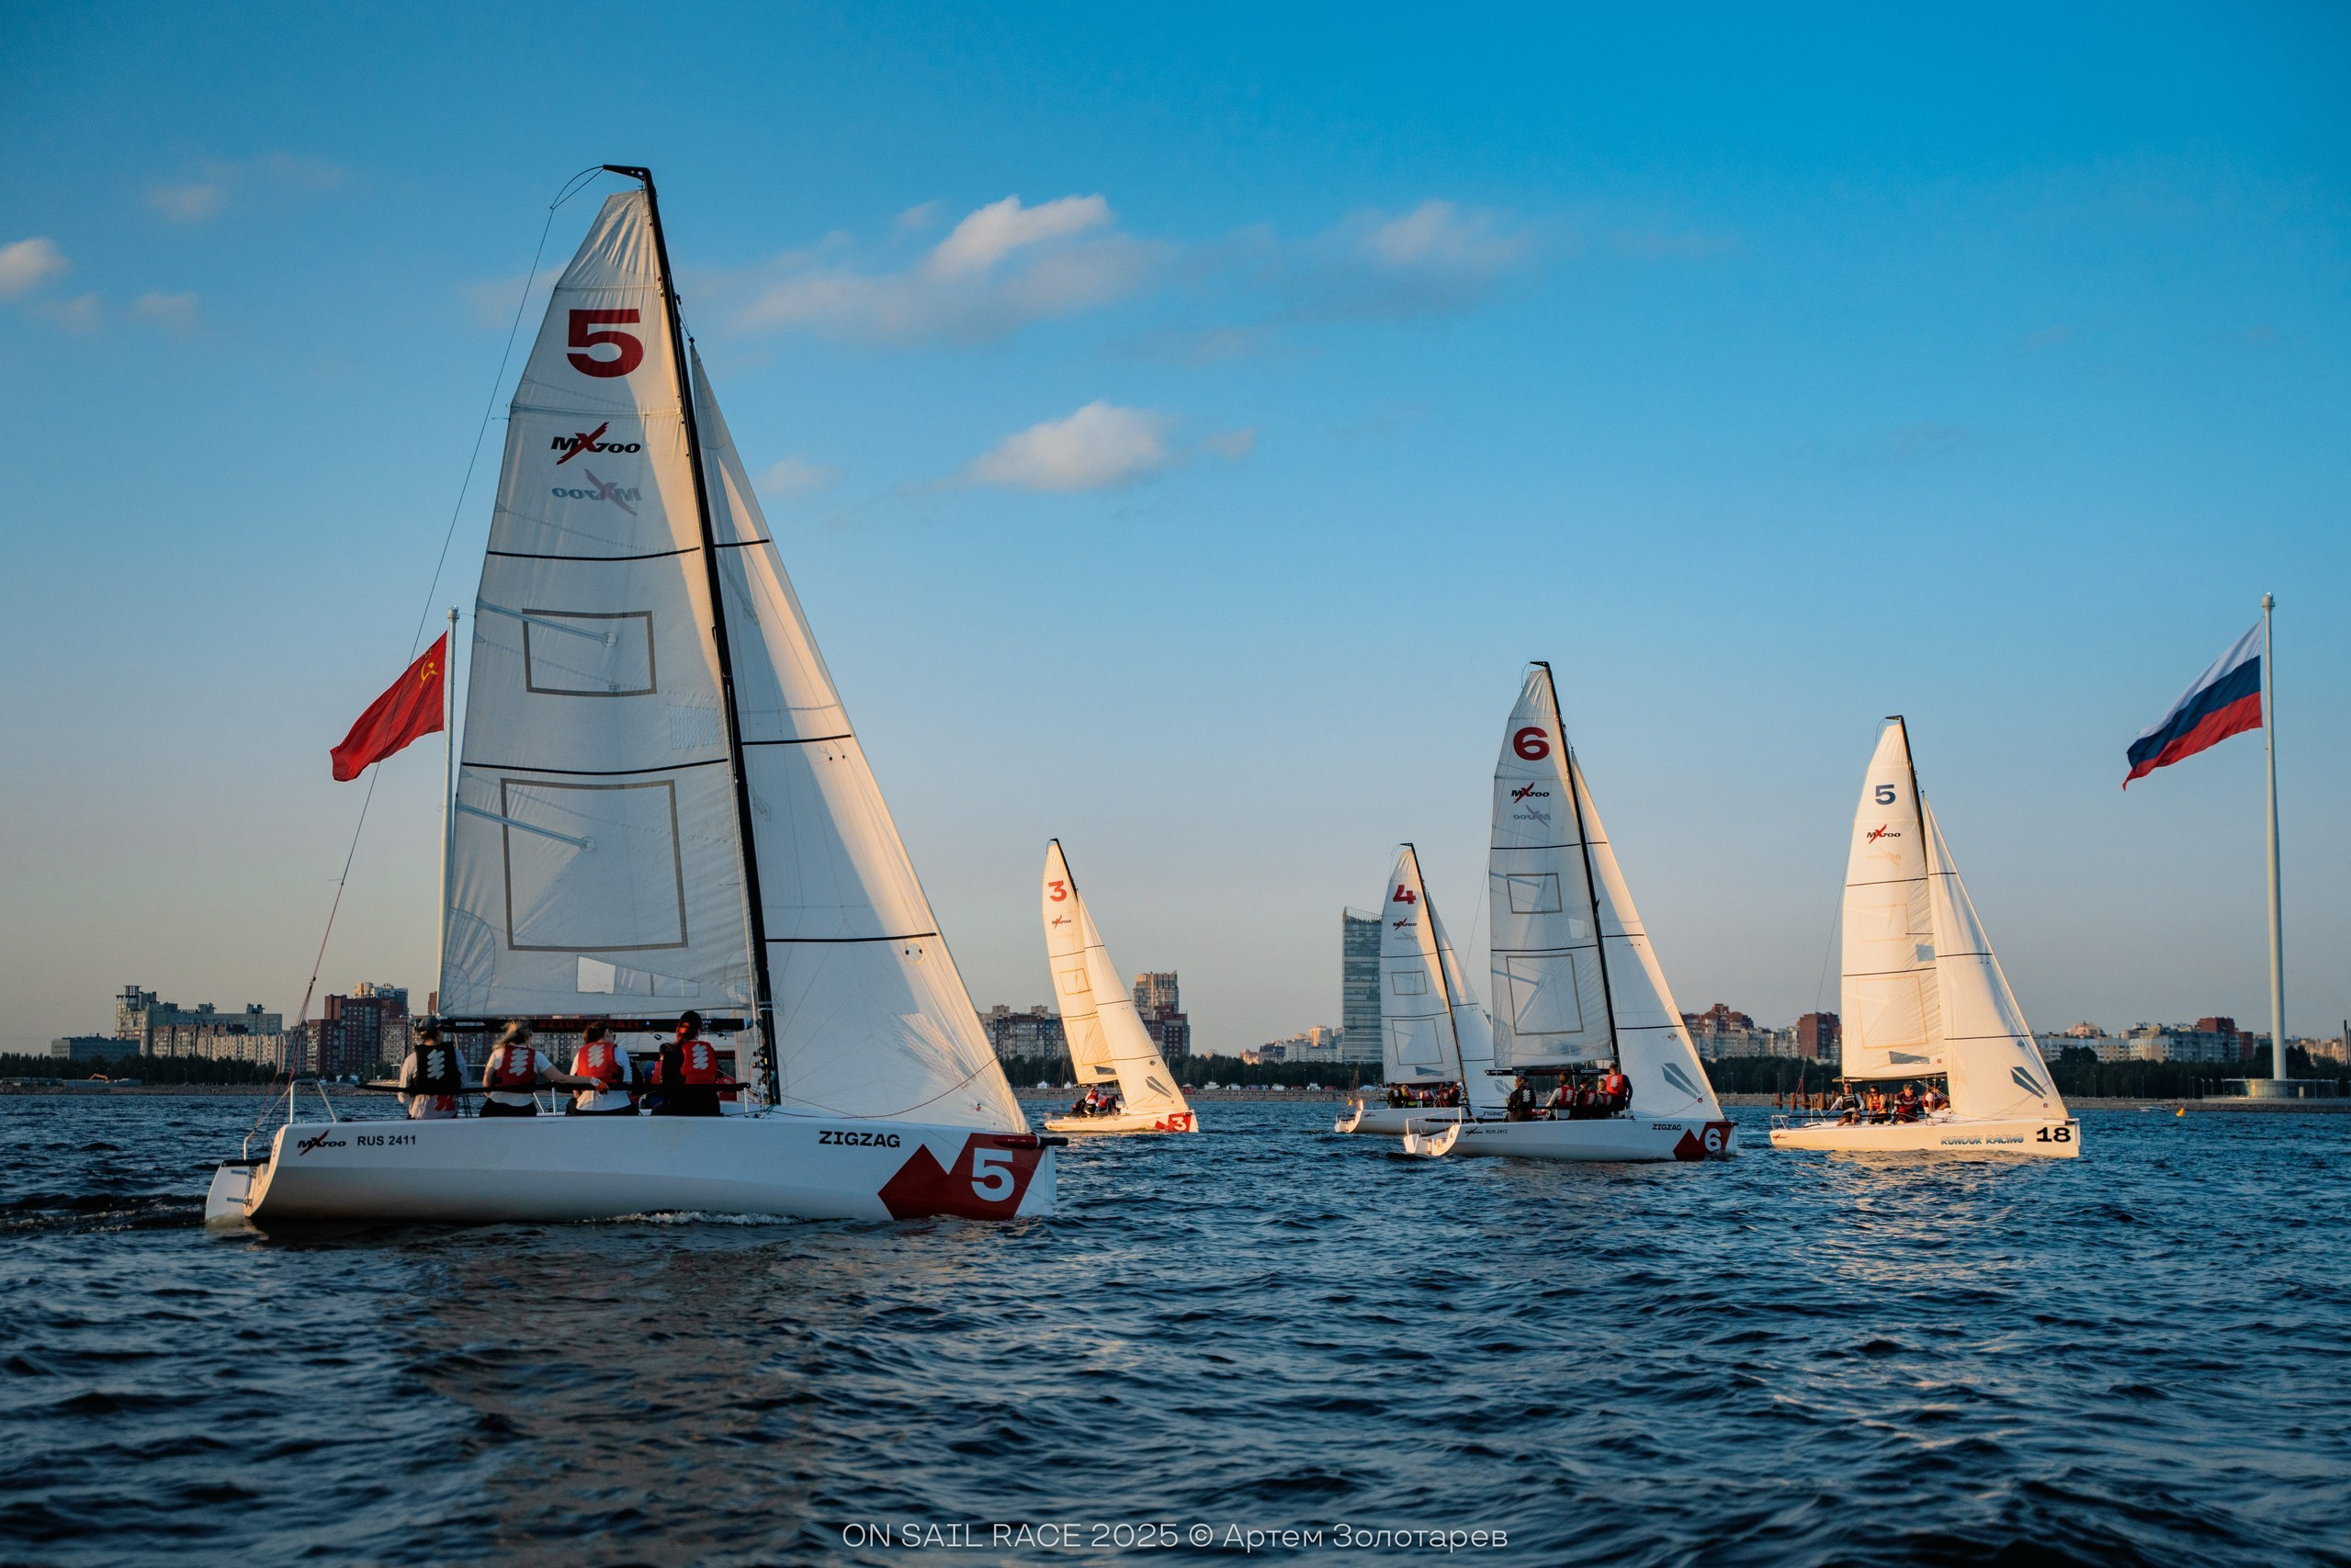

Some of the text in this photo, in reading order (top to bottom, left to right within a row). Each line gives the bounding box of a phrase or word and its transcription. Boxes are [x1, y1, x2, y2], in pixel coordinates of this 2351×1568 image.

[567, 309, 643, 378] 5
[551, 422, 640, 465] MX700
[1513, 727, 1550, 761] 6
[1511, 782, 1550, 804] MX700
[1875, 784, 1896, 805] 5
[1867, 824, 1901, 844] MX700
[1048, 880, 1068, 902] 3
[1393, 885, 1417, 905] 4
[1171, 1117, 1187, 1131] 3
[2036, 1126, 2071, 1143] 18
[297, 1129, 416, 1156] MX700 RUS 2411
[819, 1131, 900, 1148] ZIGZAG
[1704, 1127, 1722, 1152] 6
[1986, 1134, 2024, 1145] RACING
[971, 1147, 1015, 1202] 5
